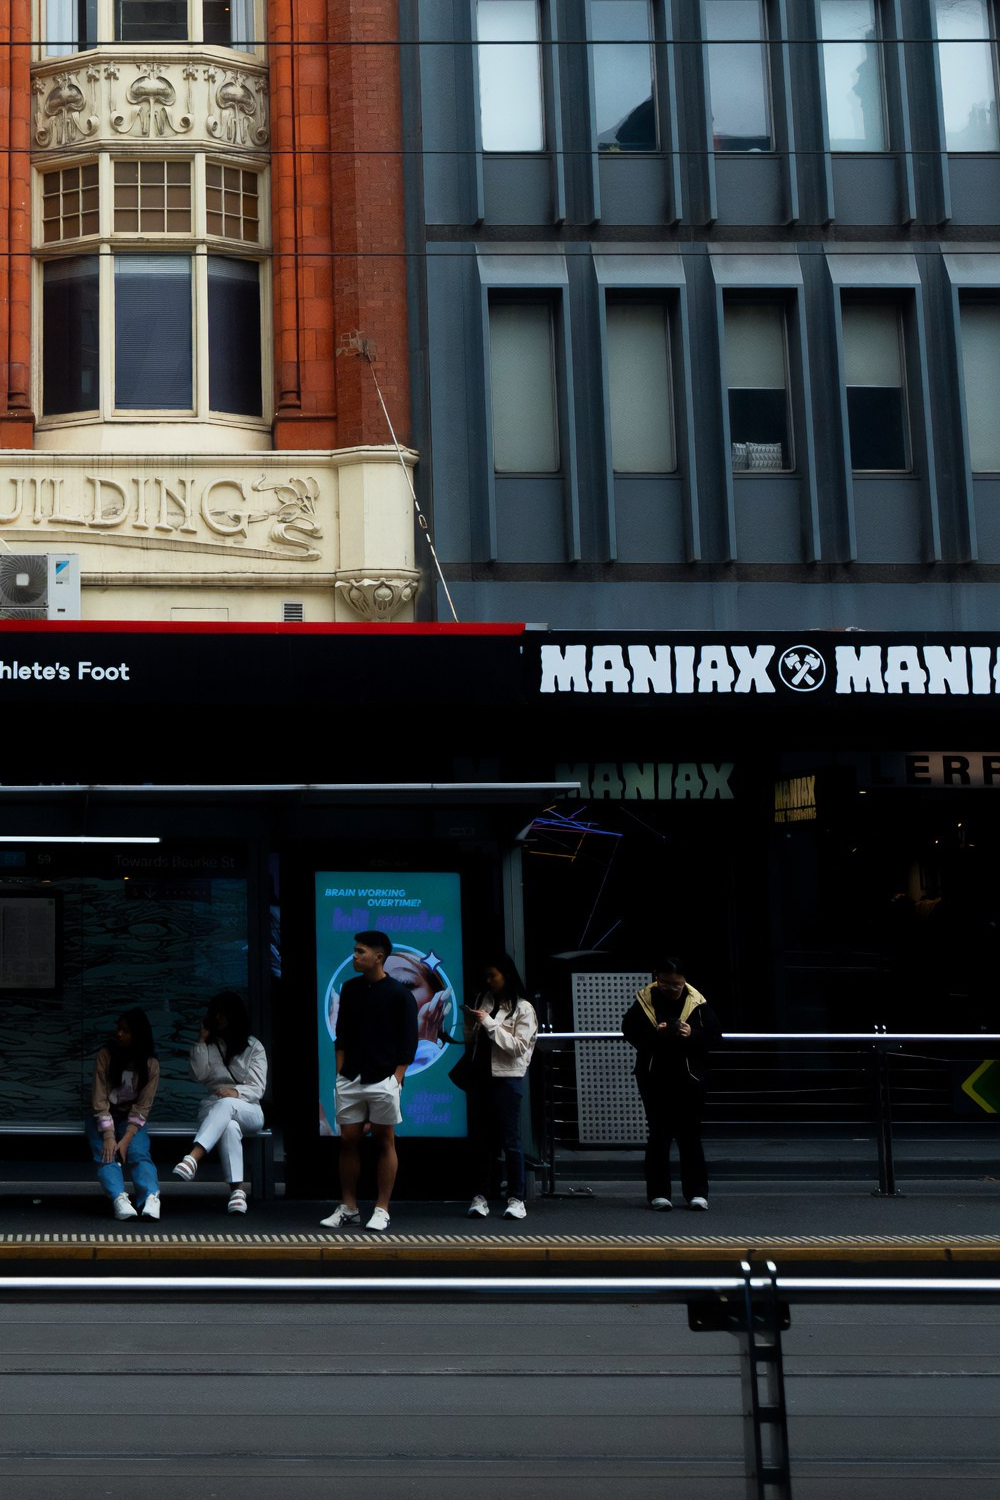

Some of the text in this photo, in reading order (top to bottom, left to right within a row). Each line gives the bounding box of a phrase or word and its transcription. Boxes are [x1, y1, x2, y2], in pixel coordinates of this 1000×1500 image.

[78, 661, 130, 681] Foot
[540, 645, 1000, 694] MANIAX MANI
[553, 762, 735, 799] MANIAX
[774, 775, 816, 810] MANIAX
[325, 888, 406, 898] BRAIN WORKING
[367, 898, 421, 908] OVERTIME?
